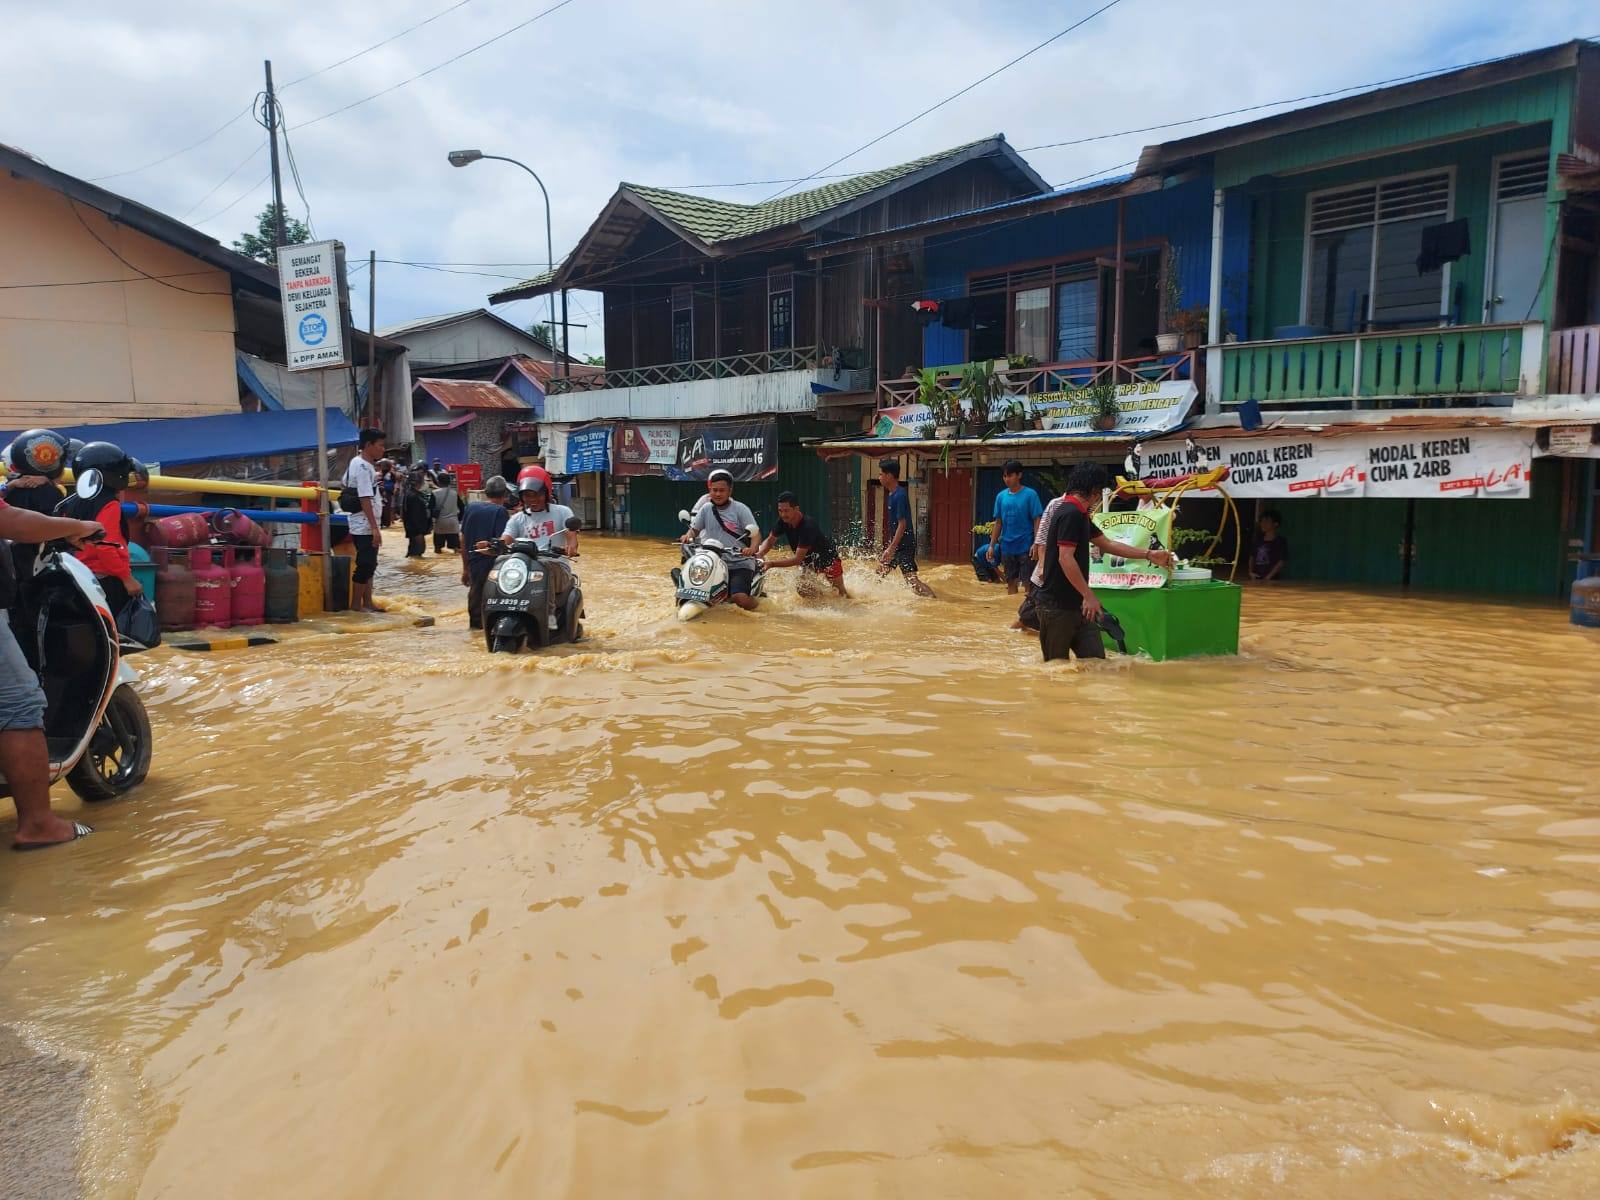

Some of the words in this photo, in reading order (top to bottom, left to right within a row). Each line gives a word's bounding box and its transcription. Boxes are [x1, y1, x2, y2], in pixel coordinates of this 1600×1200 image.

[291, 255, 321, 267] SEMANGAT
[295, 266, 319, 278] BEKERJA
[286, 280, 303, 291] TANPA
[304, 276, 331, 288] NARKOBA
[288, 292, 301, 302] DEMI
[302, 287, 331, 300] KELUARGA
[295, 300, 327, 312] SEJAHTERA
[317, 351, 339, 360] AMAN
[1140, 382, 1160, 394] DAN
[899, 413, 914, 425] SMK
[1126, 416, 1149, 426] 2017
[713, 439, 732, 451] TETAP
[1369, 444, 1417, 464] MODAL
[1422, 437, 1470, 459] KEREN
[754, 452, 763, 465] 16
[1148, 451, 1183, 469] MODAL
[1230, 449, 1270, 468] MODAL
[1273, 443, 1313, 461] KEREN
[1231, 467, 1264, 485] CUMA
[1267, 463, 1298, 482] 24RB
[1370, 463, 1407, 482] CUMA
[1413, 459, 1451, 479] 24RB
[1111, 513, 1139, 527] DAWET
